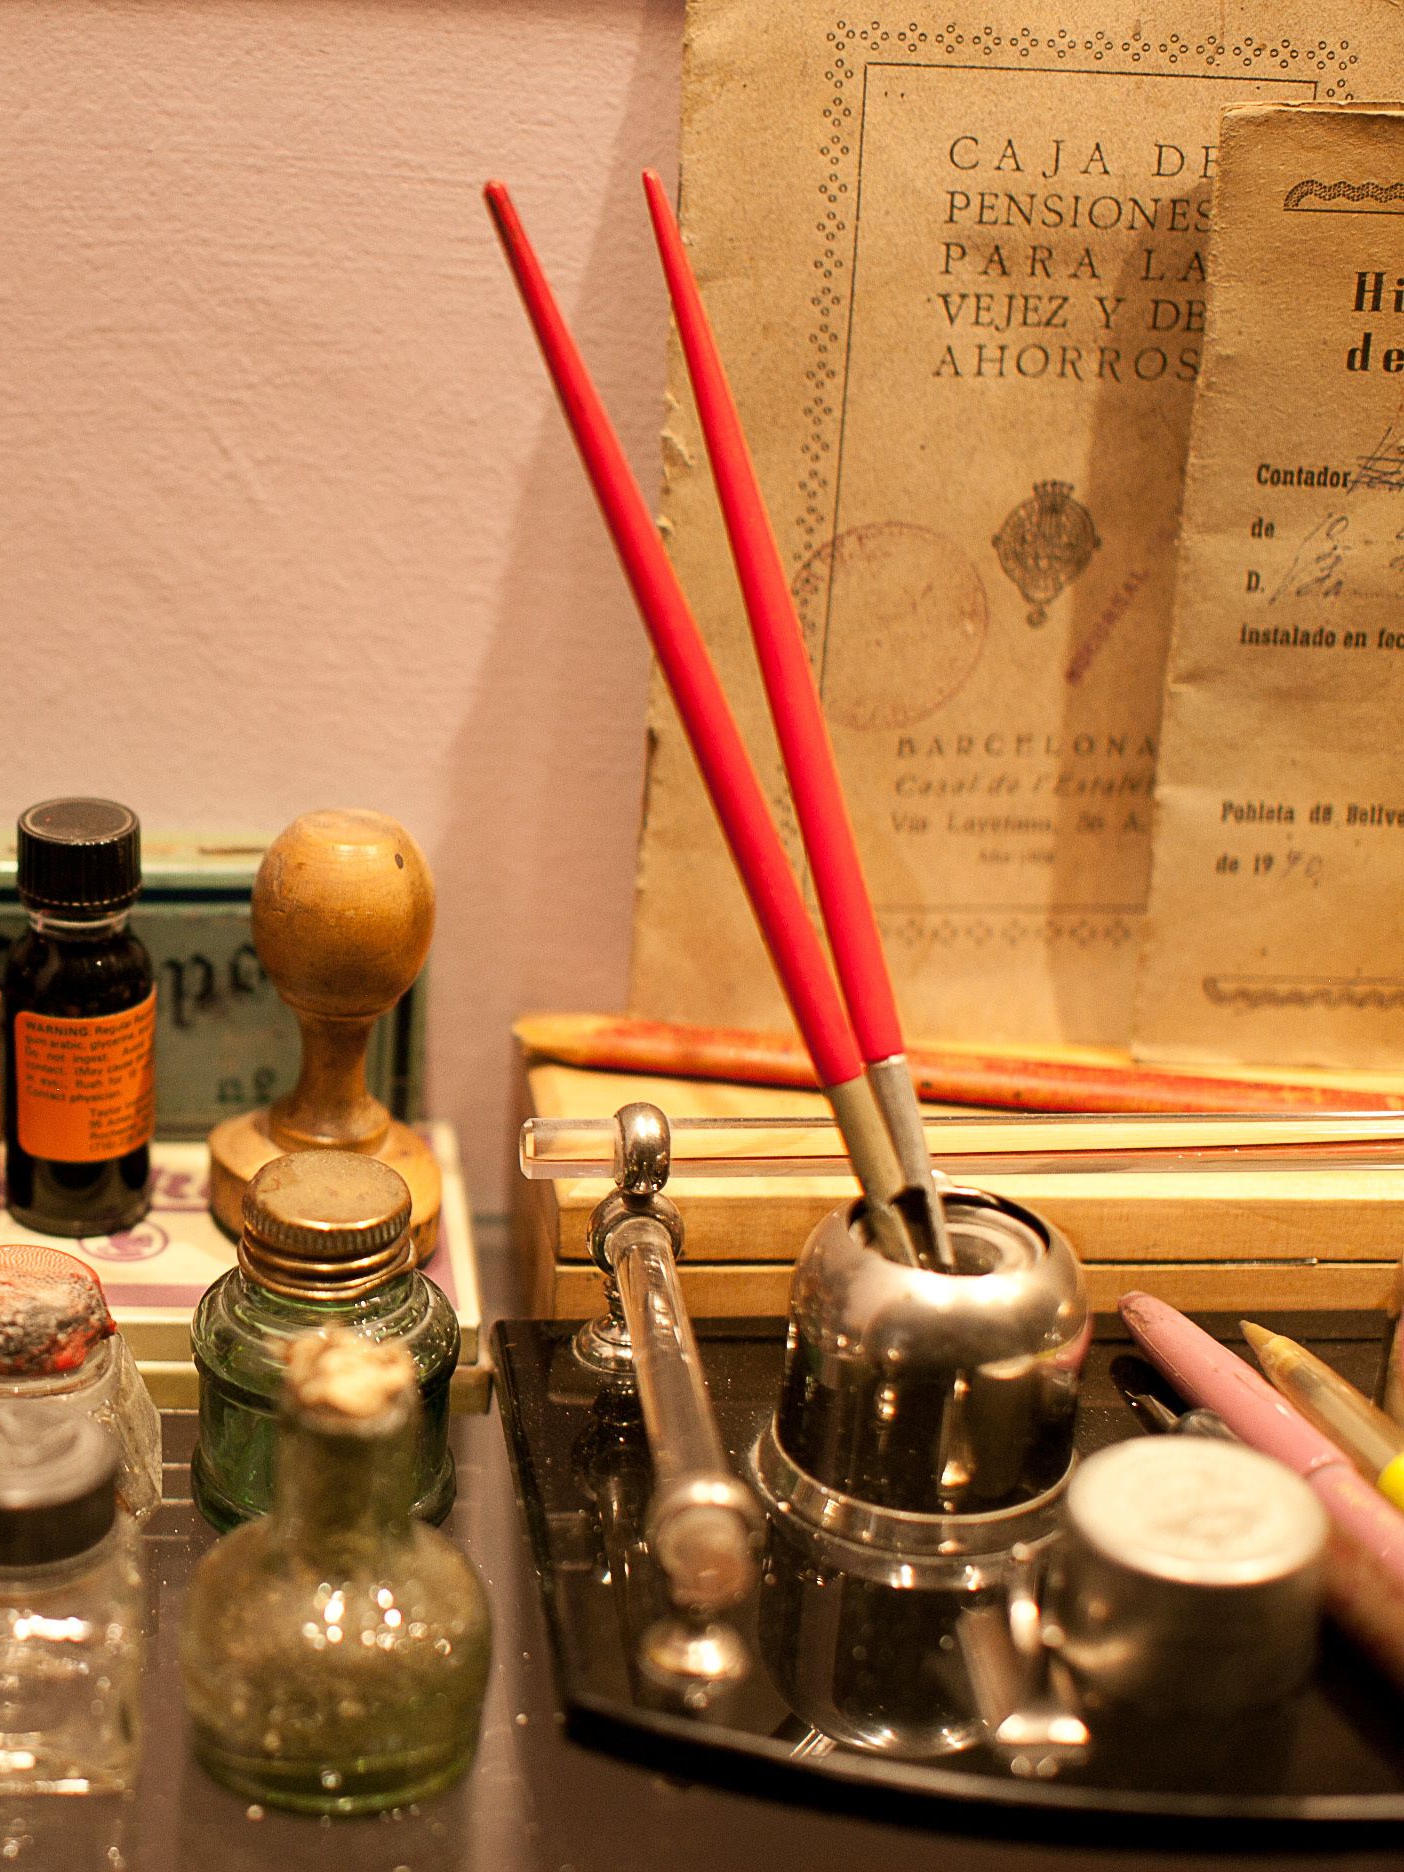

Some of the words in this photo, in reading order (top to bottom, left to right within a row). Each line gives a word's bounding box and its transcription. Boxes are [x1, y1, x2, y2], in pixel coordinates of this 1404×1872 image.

[949, 135, 1111, 179] CAJA
[944, 190, 1211, 232] PENSIONES
[940, 241, 1101, 279] PARA
[1141, 248, 1207, 282] LA
[937, 292, 1070, 332] VEJEZ
[1096, 296, 1124, 329] Y
[1151, 299, 1206, 332] DE
[932, 344, 1200, 382] AHORROS
[1346, 332, 1404, 372] de
[1257, 463, 1351, 487] Contador
[1251, 516, 1275, 538] de
[1247, 569, 1264, 592] D.
[1240, 625, 1336, 647] Instalado
[1343, 631, 1367, 647] en
[896, 732, 1158, 759] BARCELONA
[1214, 853, 1240, 875] de
